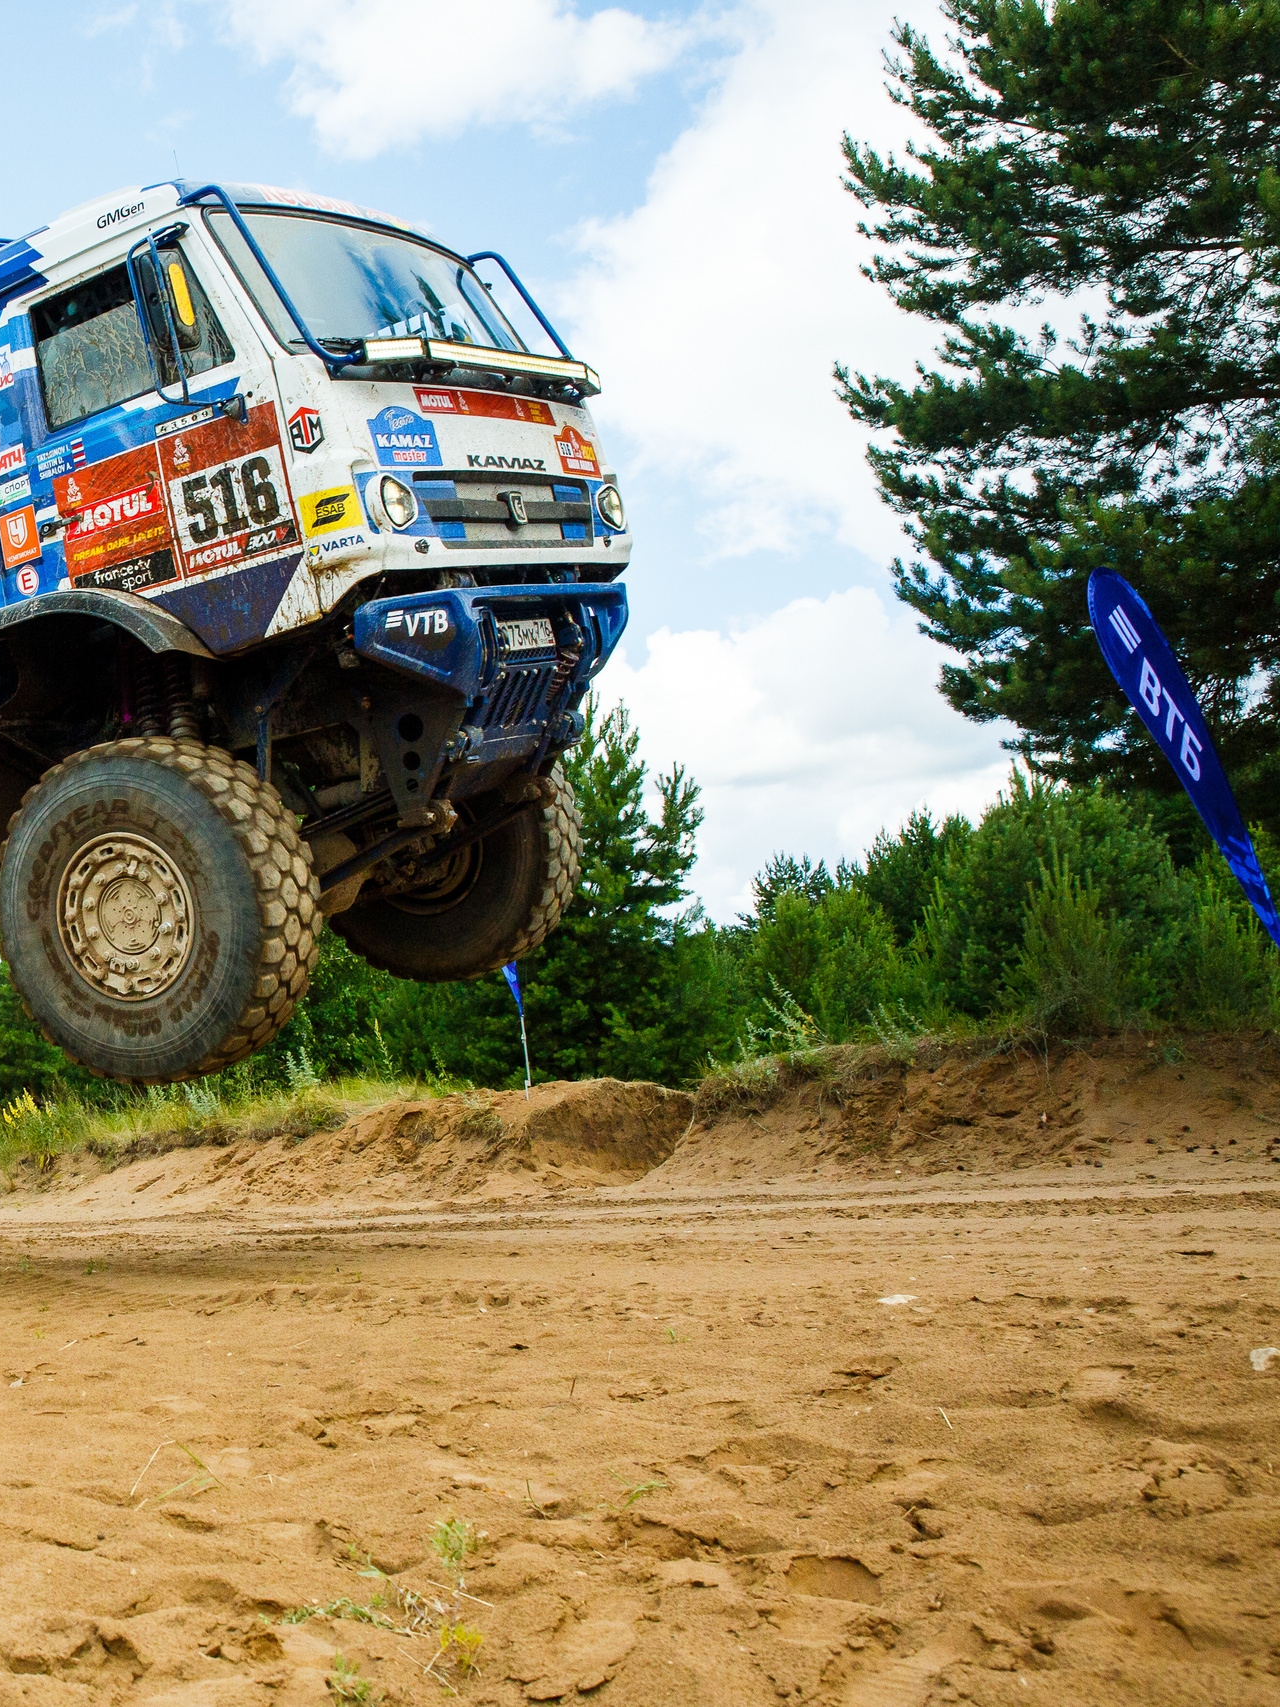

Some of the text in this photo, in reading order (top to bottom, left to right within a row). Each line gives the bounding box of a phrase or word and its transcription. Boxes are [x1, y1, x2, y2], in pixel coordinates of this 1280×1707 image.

[97, 201, 145, 229] GMGen
[420, 394, 453, 408] MOTUL
[376, 434, 433, 448] KAMAZ
[393, 450, 426, 462] master
[467, 454, 547, 471] KAMAZ
[4, 479, 30, 494] СПОРТ
[182, 456, 281, 544] 516
[74, 490, 153, 535] MOTUL
[315, 503, 345, 518] ESAB
[321, 534, 365, 553] VARTA
[189, 541, 243, 569] MOTUL
[121, 570, 154, 591] sport
[404, 610, 449, 637] VTB
[1139, 657, 1202, 782] ВТБ
